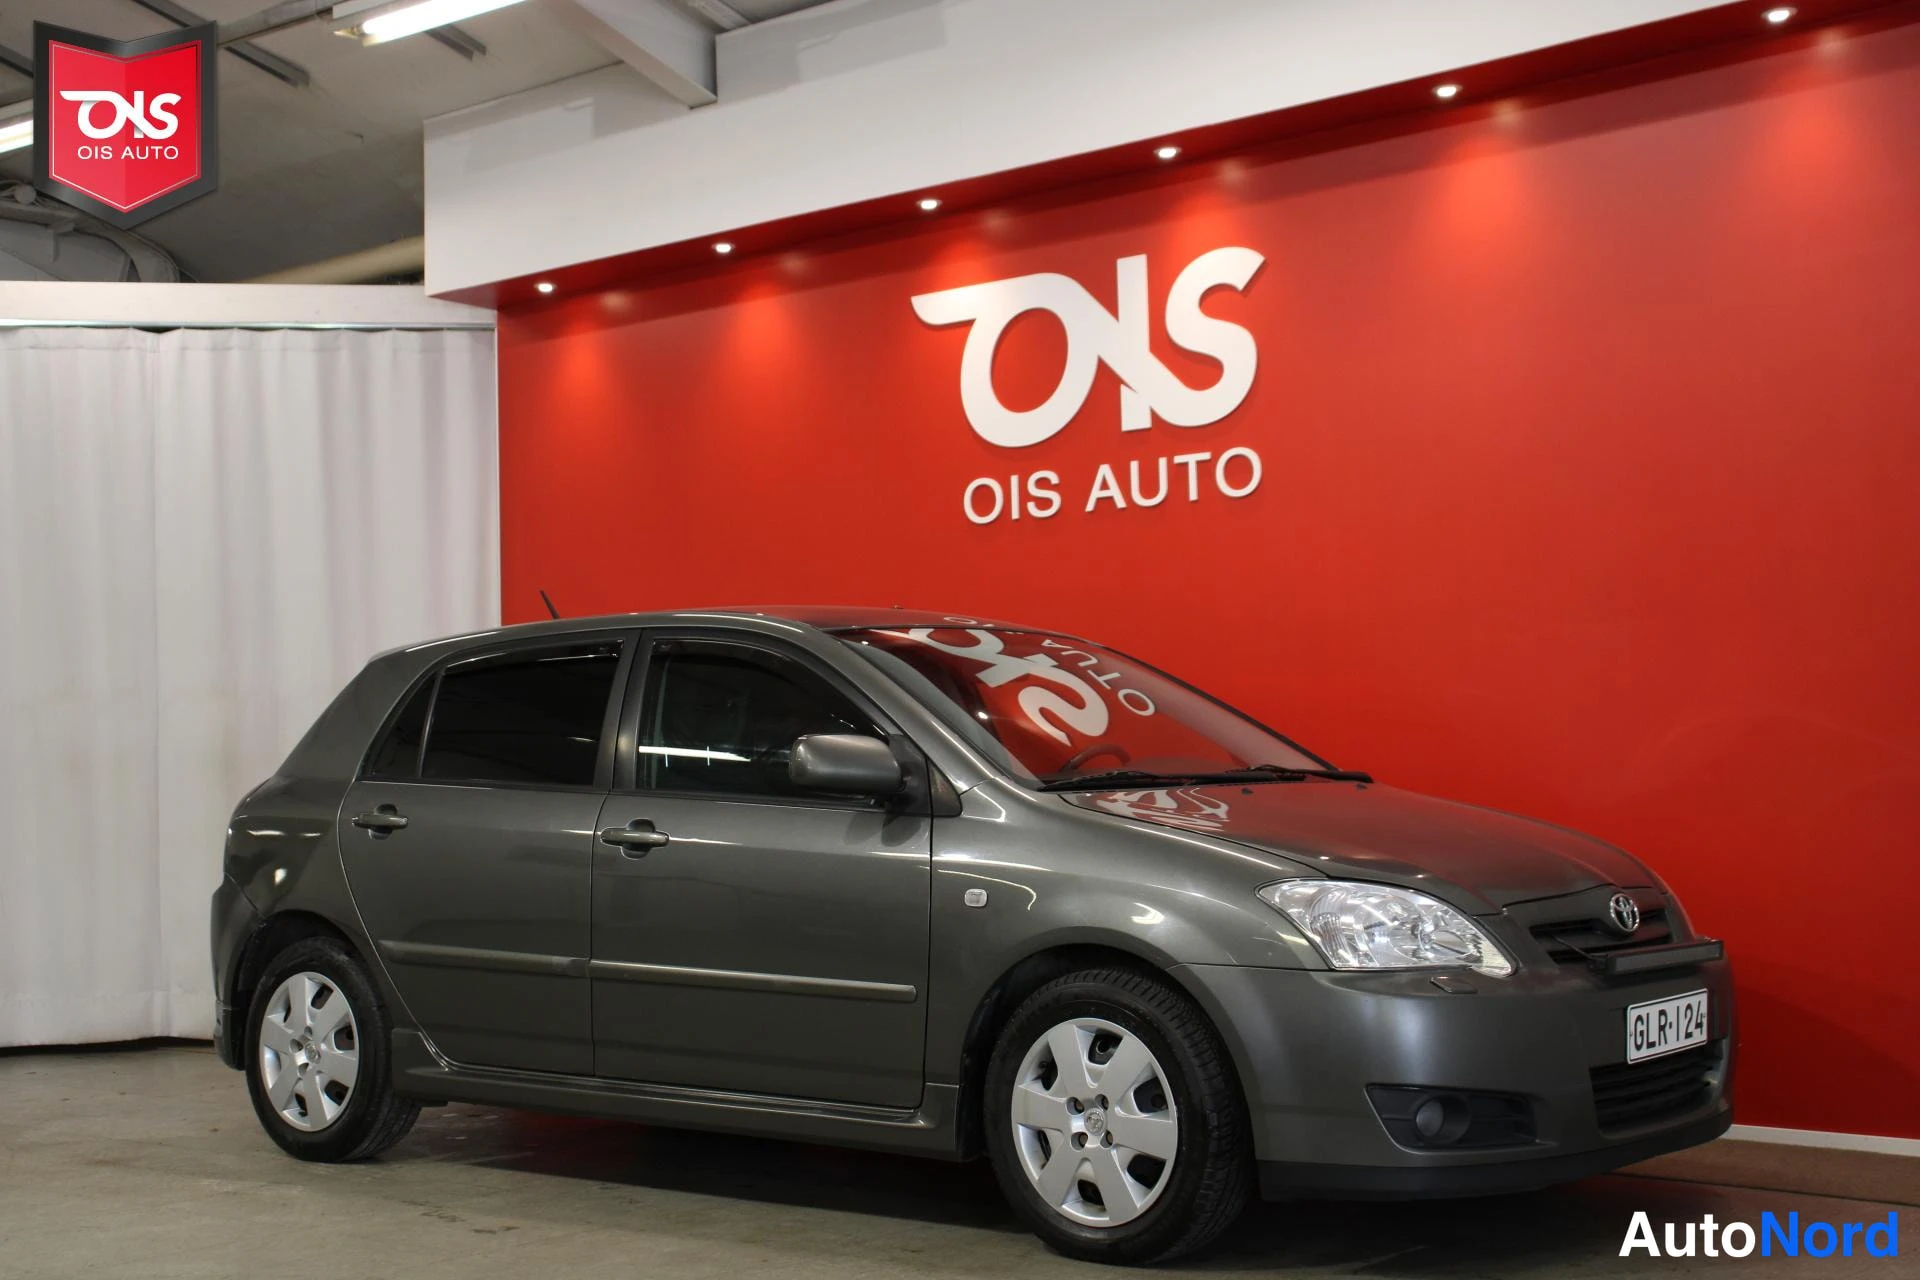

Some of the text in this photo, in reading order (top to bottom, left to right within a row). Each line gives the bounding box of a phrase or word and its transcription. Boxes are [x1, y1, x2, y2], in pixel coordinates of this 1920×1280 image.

[963, 446, 1263, 525] OIS AUTO
[1634, 1000, 1704, 1051] GLR-124
